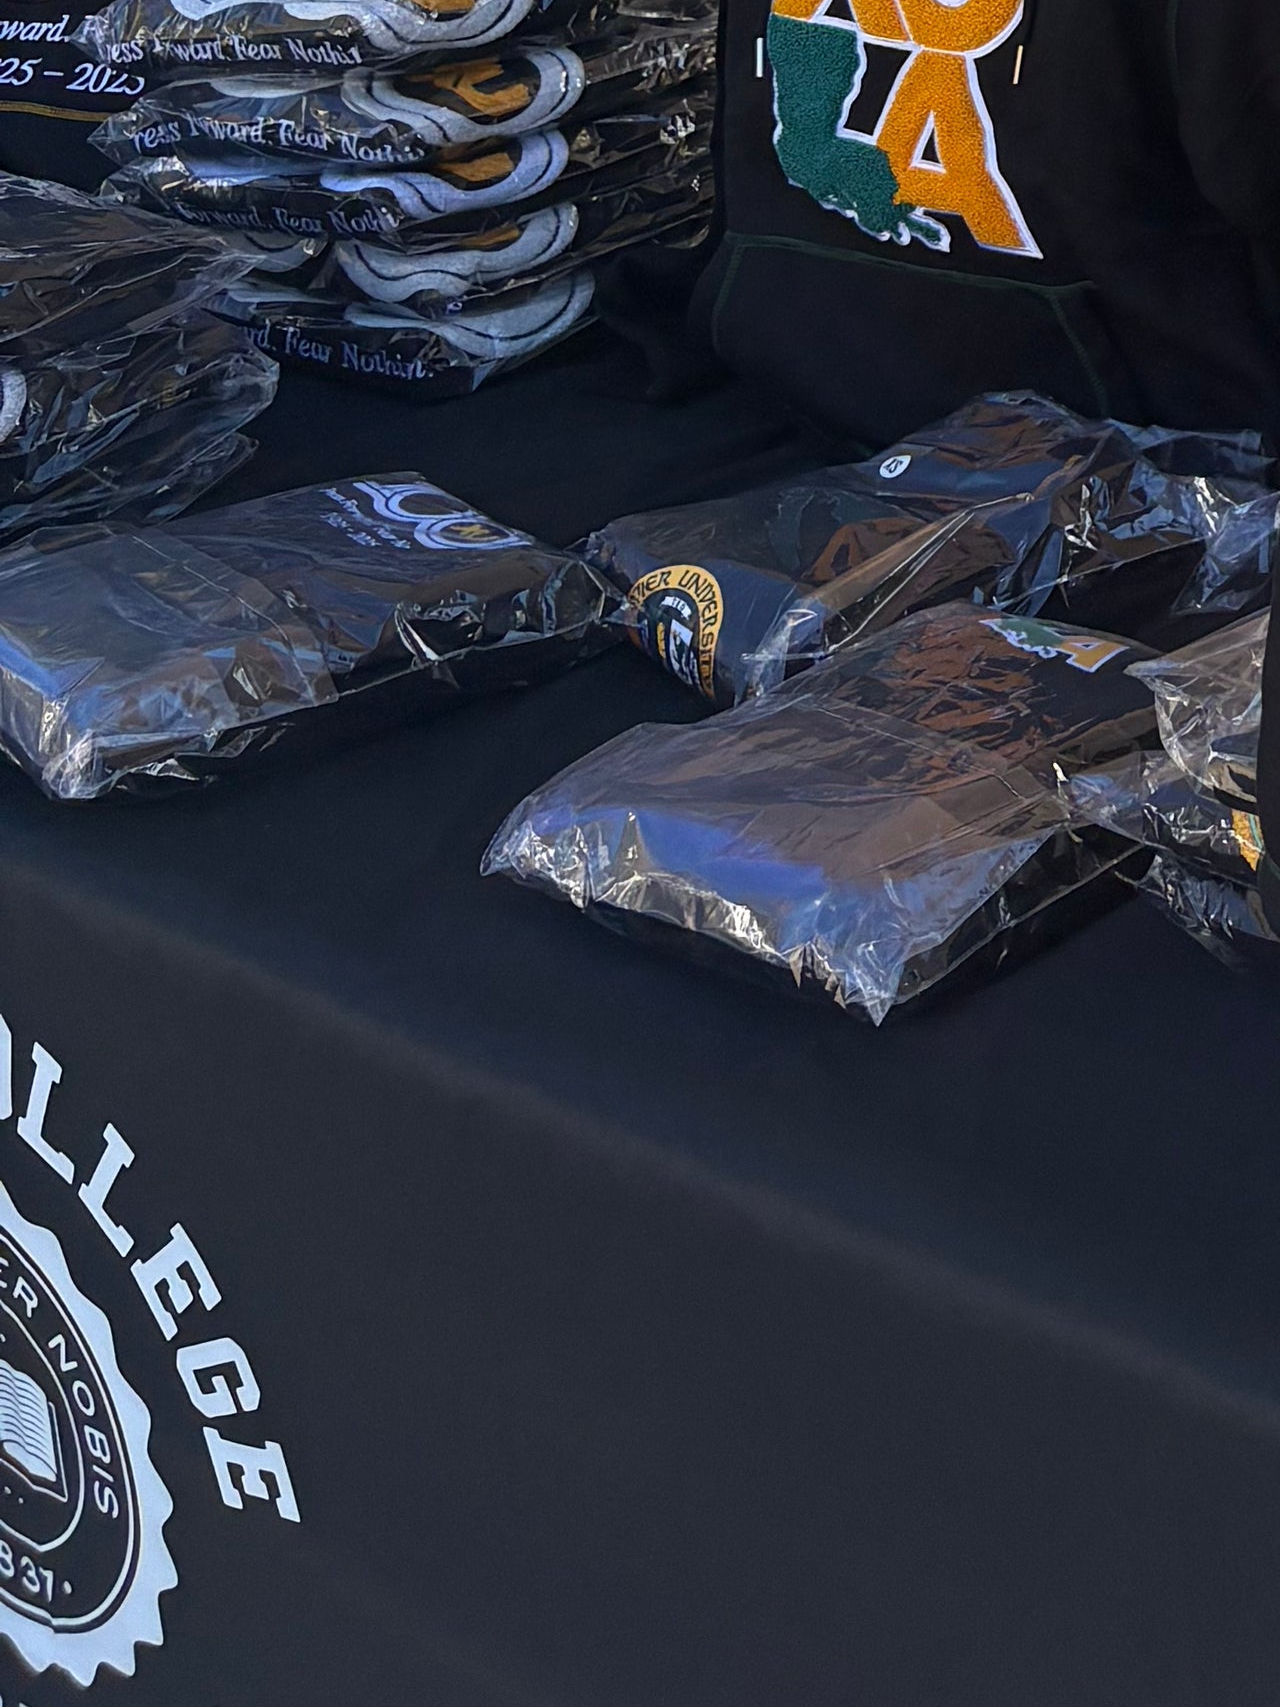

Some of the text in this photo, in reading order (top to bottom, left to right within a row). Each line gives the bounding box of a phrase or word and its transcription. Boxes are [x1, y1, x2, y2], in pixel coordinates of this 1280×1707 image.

[0, 14, 70, 43] ward.
[0, 1012, 301, 1524] LLEGE
[47, 1332, 120, 1520] NOBIS
